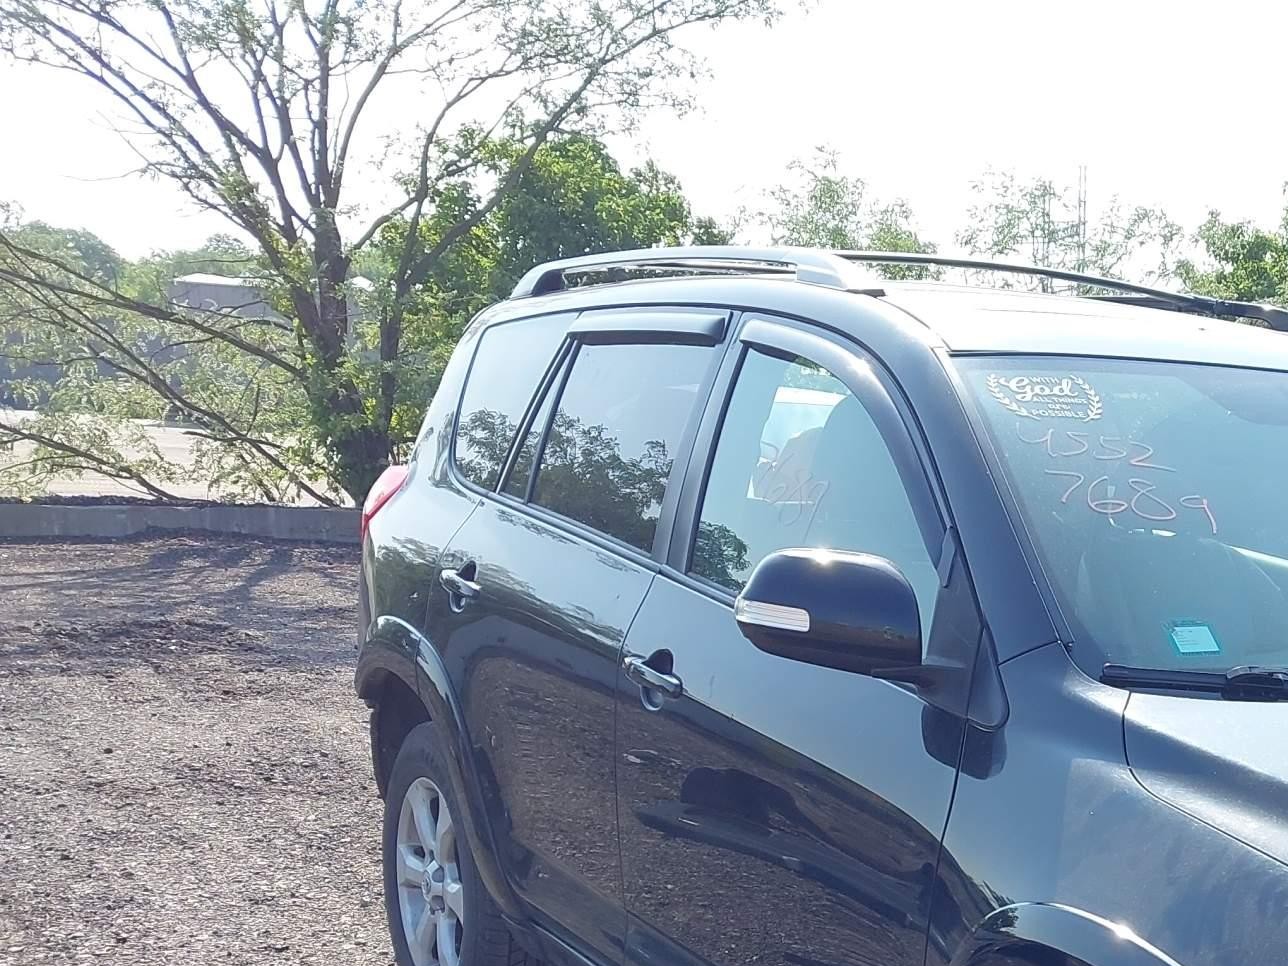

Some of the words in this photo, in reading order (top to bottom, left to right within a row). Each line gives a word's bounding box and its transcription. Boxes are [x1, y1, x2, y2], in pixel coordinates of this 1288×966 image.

[999, 376, 1078, 402] God
[1031, 410, 1088, 418] POSSIBLE
[1016, 422, 1177, 473] 4552
[1044, 468, 1217, 534] 7689
